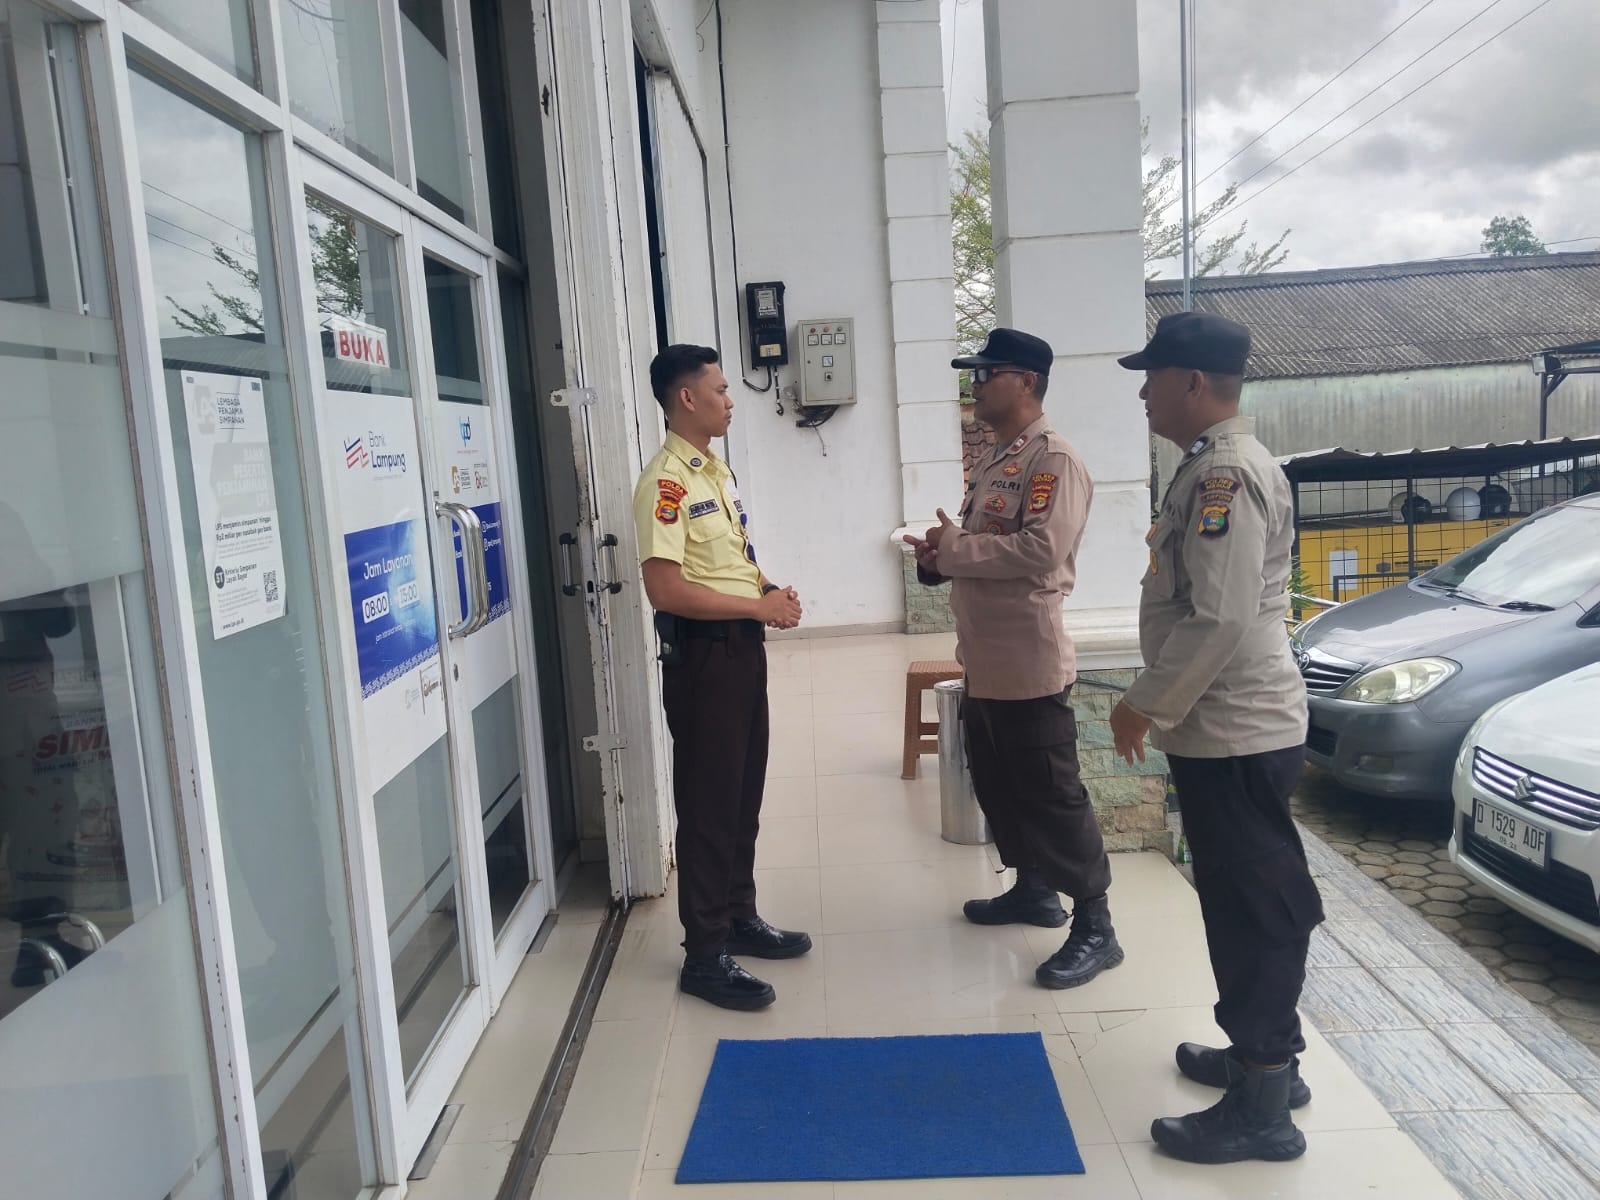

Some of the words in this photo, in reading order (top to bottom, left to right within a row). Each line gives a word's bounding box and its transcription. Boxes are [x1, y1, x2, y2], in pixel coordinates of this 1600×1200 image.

[339, 330, 385, 365] BUKA
[369, 431, 385, 448] Bank
[371, 451, 406, 473] Lampung
[661, 480, 685, 494] POLDA
[990, 480, 1020, 491] POLRI
[364, 561, 382, 580] Jam
[382, 554, 412, 575] Layanan
[364, 596, 388, 620] 08:00
[34, 726, 110, 760] SIM
[1478, 804, 1484, 823] D
[1491, 810, 1516, 839] 1529
[1523, 826, 1544, 852] ADF
